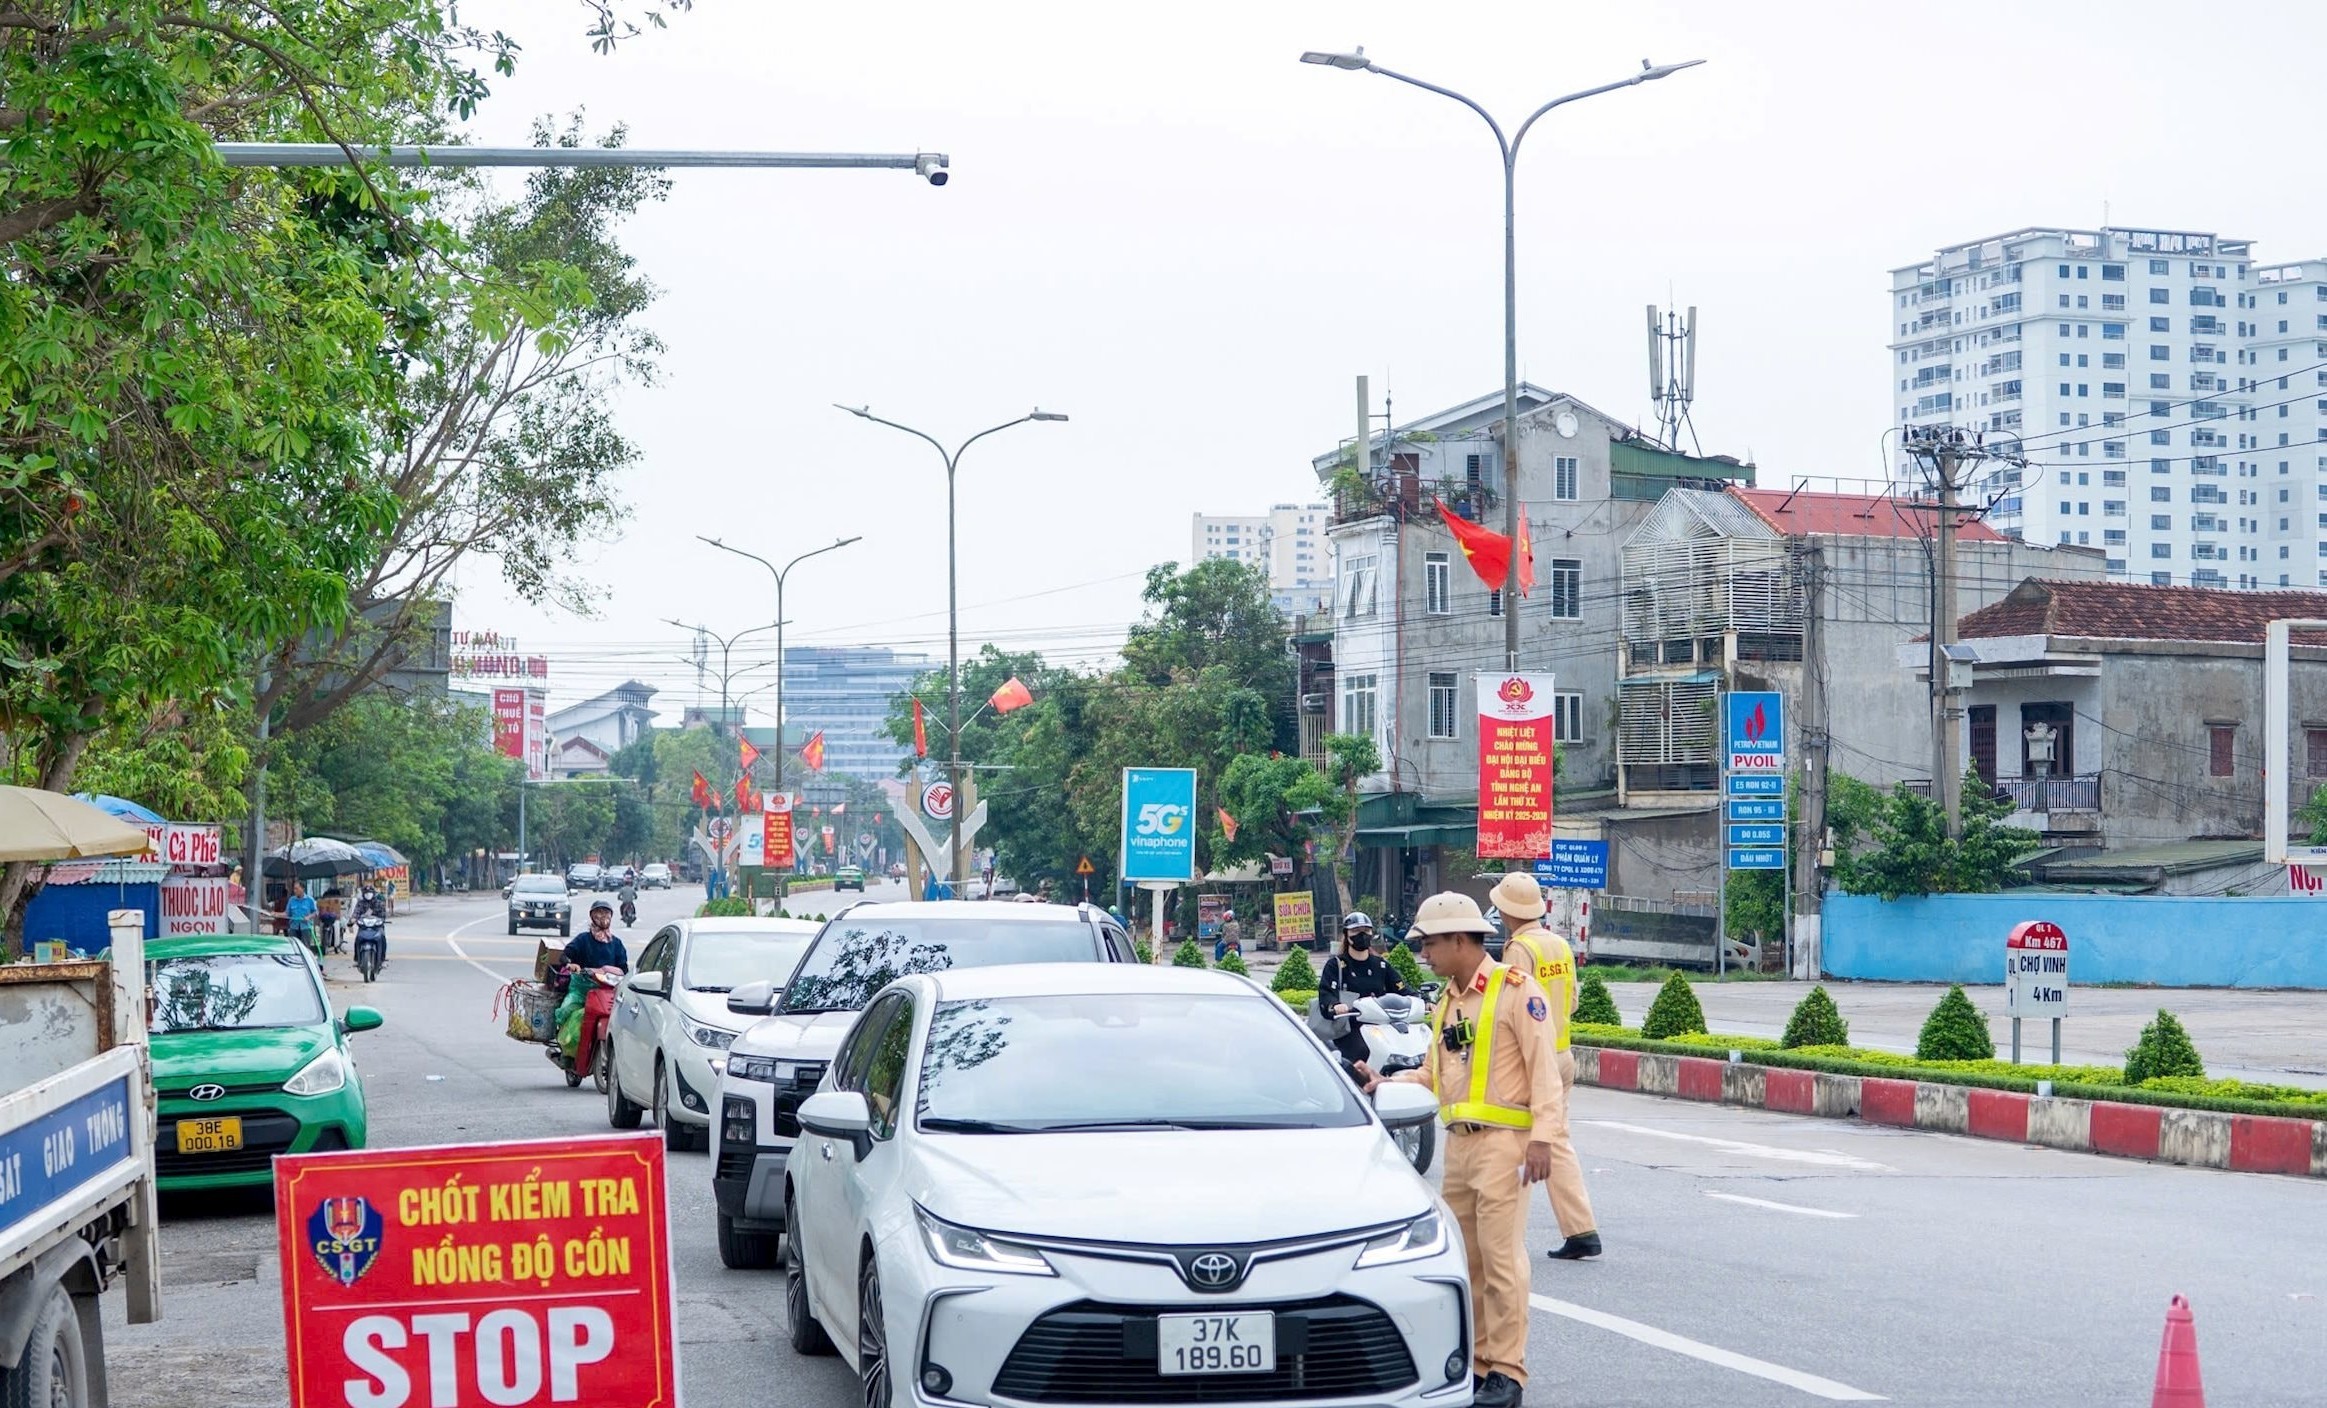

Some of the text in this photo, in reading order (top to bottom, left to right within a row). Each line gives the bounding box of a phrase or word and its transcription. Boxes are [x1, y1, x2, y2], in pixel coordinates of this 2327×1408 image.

[1734, 755, 1778, 767] PVOIL
[169, 831, 217, 863] Cà Phê
[1130, 835, 1188, 848] vinaphone
[202, 880, 224, 918] LÀO
[2025, 935, 2062, 949] Km 467
[1540, 963, 1569, 978] C.SG.T
[2020, 955, 2066, 975] CHỢ VINH
[2033, 987, 2062, 1002] 4 Km
[196, 1121, 223, 1135] 38E
[43, 1126, 74, 1178] GIAO
[87, 1101, 124, 1155] THÔNG
[185, 1135, 235, 1150] 000.18
[399, 1166, 640, 1227] CHỐT KIỂM TRA
[413, 1225, 631, 1288] NỒNG ĐỘ CỒN
[1193, 1318, 1240, 1342] 37K
[342, 1306, 615, 1408] STOP
[1176, 1344, 1262, 1371] 189.60
